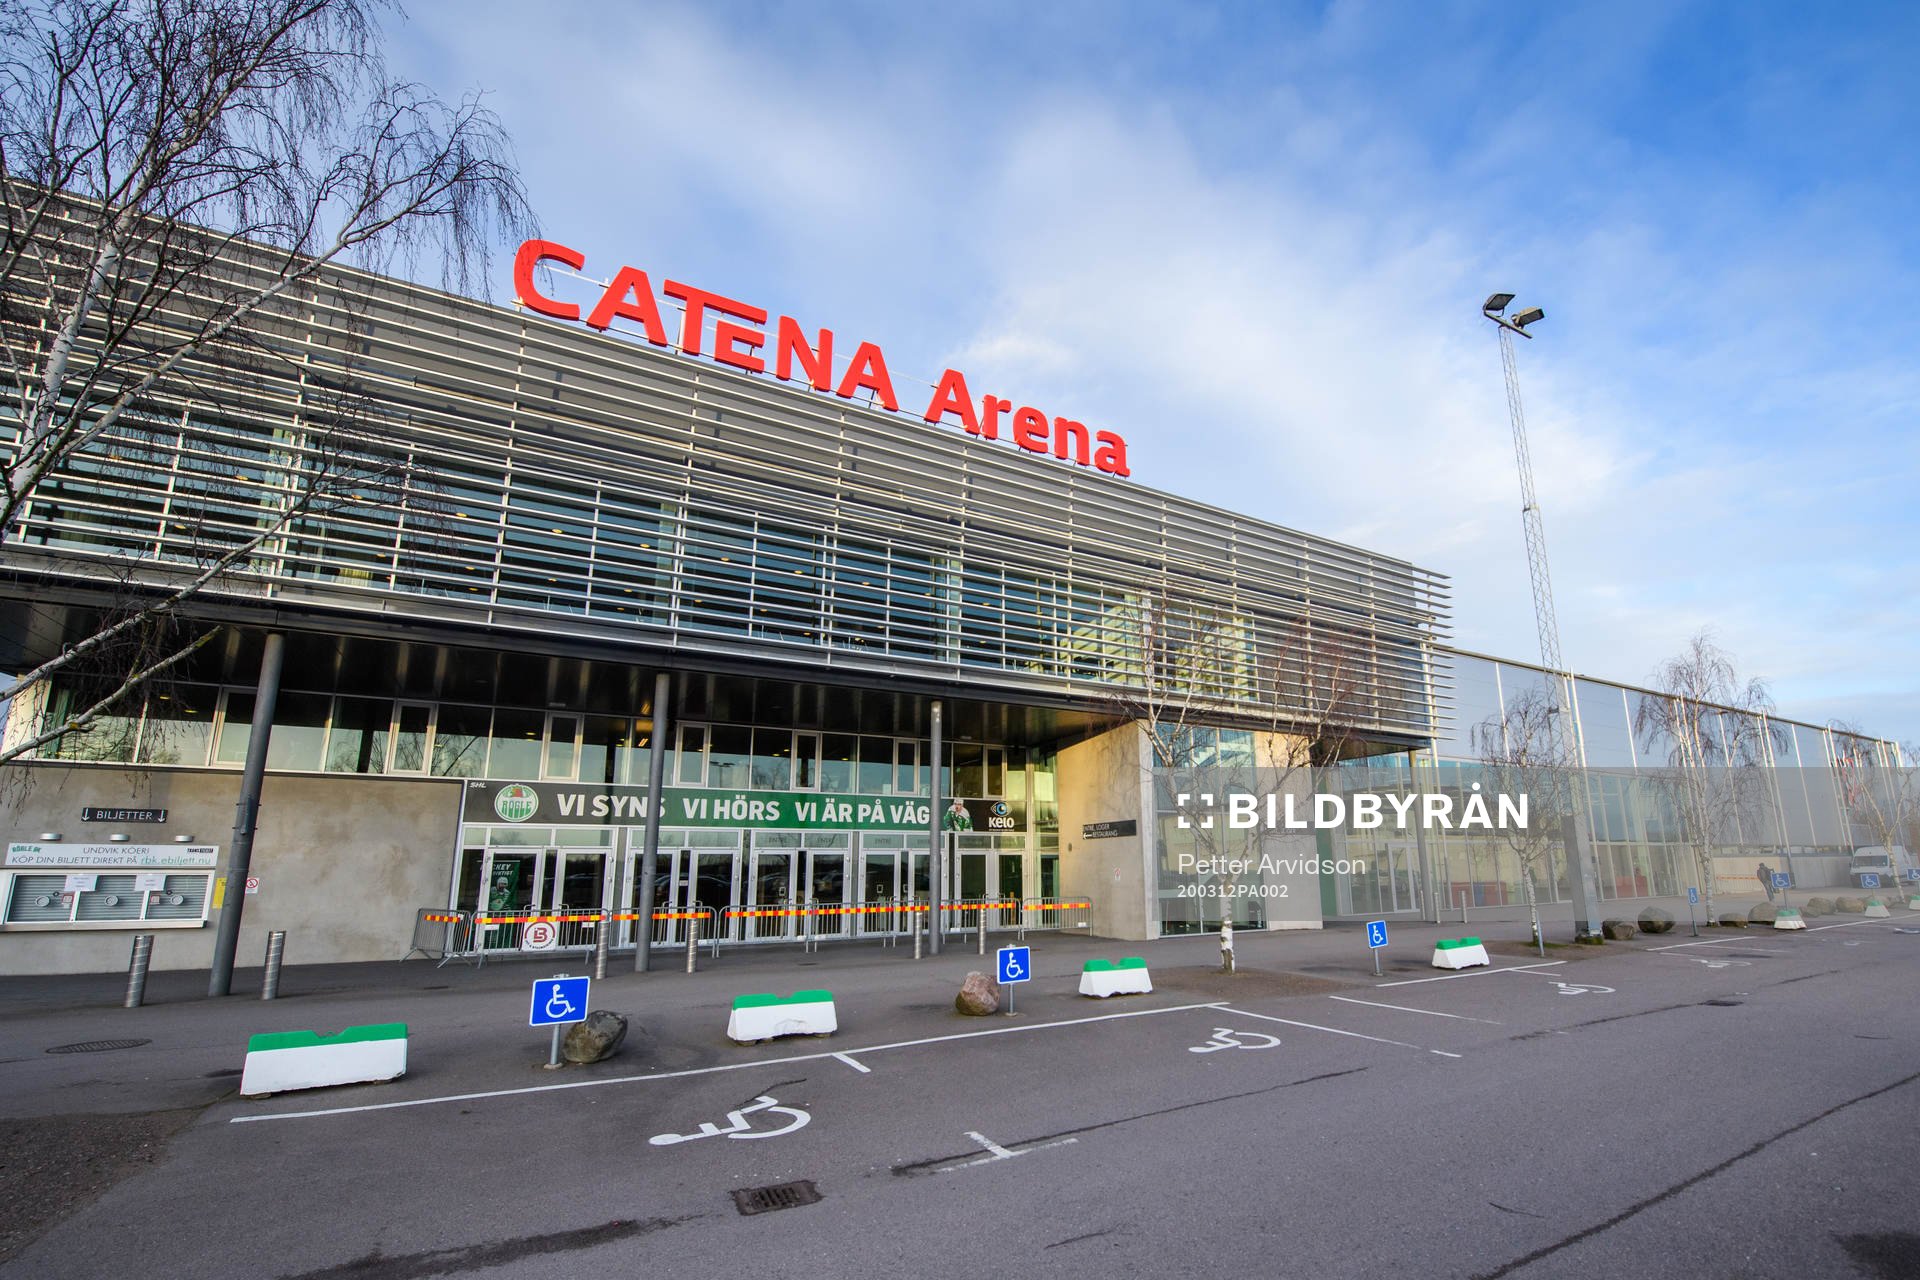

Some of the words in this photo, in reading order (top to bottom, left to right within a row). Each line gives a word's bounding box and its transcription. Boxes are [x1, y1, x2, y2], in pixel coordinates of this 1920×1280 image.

[514, 240, 898, 411] CATENA
[924, 369, 1131, 477] Arena
[97, 810, 153, 820] BILJETTER
[557, 794, 586, 816] VI
[683, 798, 707, 819] VI
[713, 795, 780, 821] HÖRS
[795, 802, 817, 822] VI
[822, 798, 853, 823] ÄR
[858, 799, 885, 823] PÅ
[890, 801, 930, 825] VÄG
[36, 856, 55, 864] DIN
[57, 856, 90, 864] BILJETT
[126, 856, 138, 864] PÅ
[140, 855, 211, 866] rbk.ebiljett.nu
